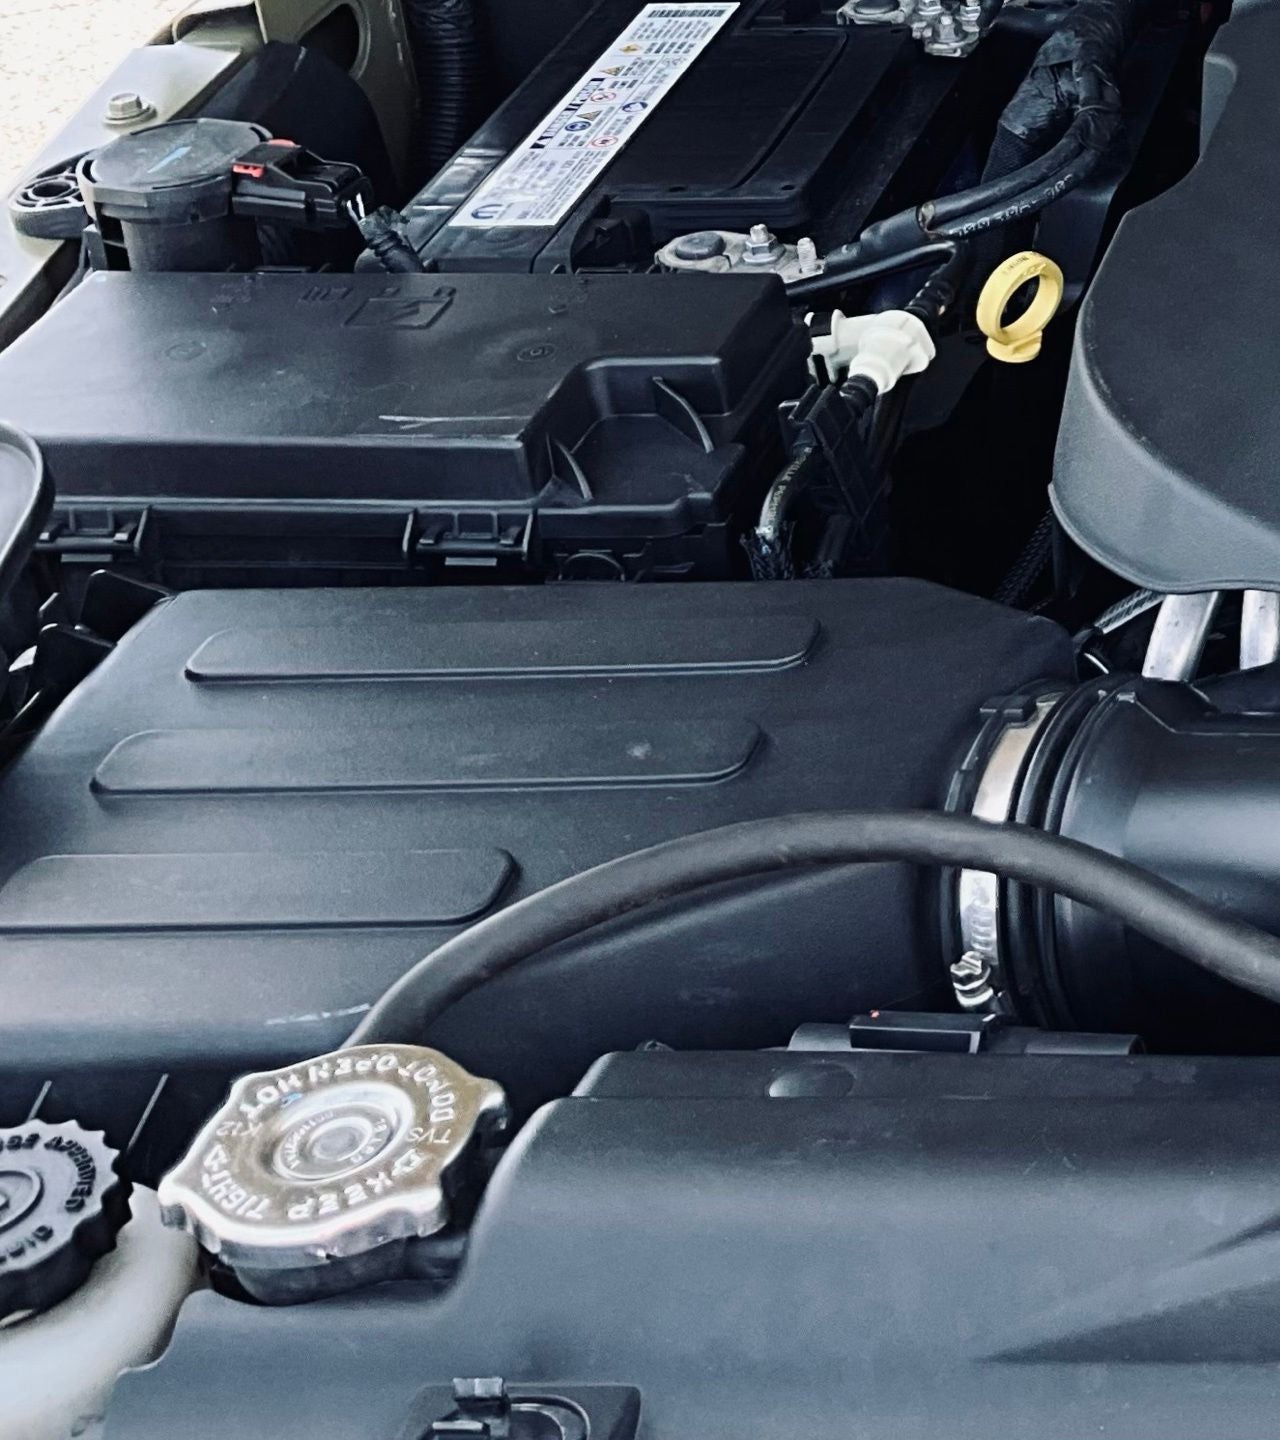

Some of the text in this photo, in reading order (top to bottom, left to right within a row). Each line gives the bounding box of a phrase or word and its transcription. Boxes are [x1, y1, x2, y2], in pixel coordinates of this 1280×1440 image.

[240, 1074, 303, 1120] HOT
[202, 1171, 394, 1221] KEEP TIGHT
